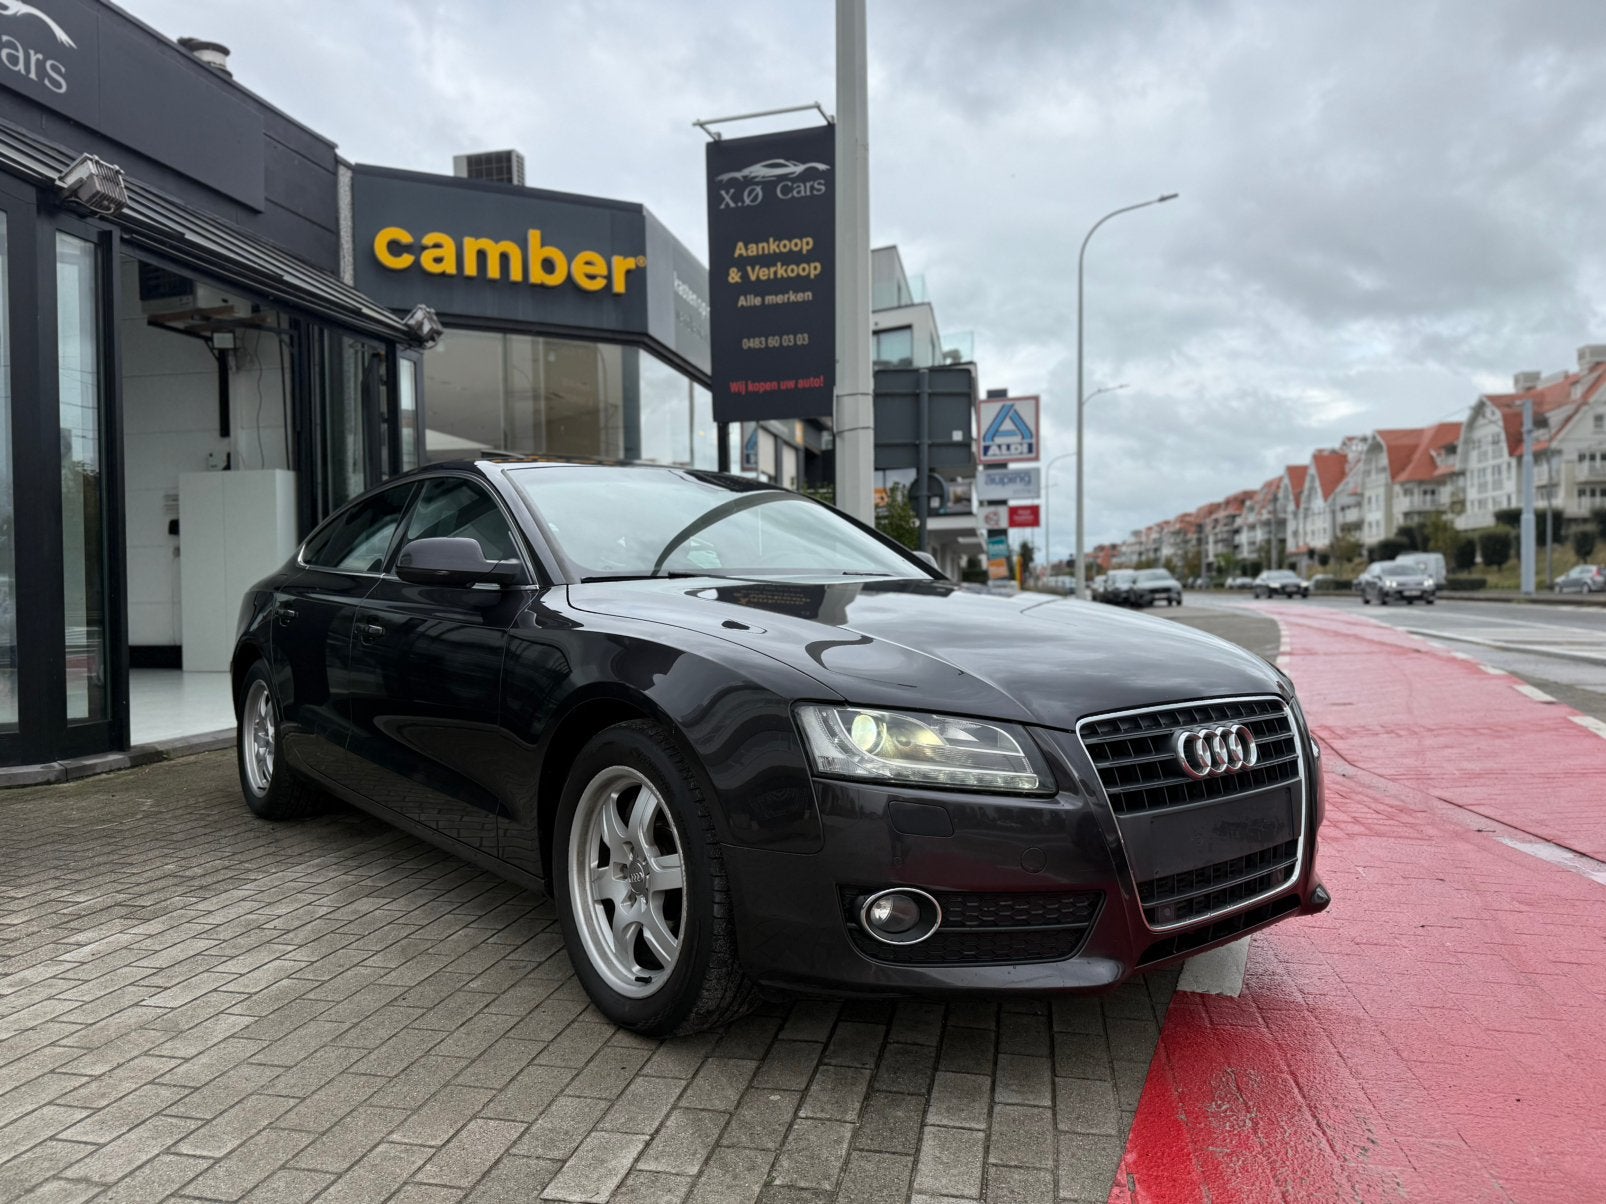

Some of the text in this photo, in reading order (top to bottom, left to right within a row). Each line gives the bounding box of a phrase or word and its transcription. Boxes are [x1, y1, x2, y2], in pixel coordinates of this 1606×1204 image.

[776, 178, 826, 200] Cars
[733, 236, 815, 258] Aankoop
[373, 226, 637, 295] camber
[727, 260, 822, 284] & Verkoop
[737, 289, 813, 308] Alle merken
[741, 333, 809, 350] 0483 60 03 03
[729, 375, 824, 395] Wij kopen uw auto!
[986, 442, 1029, 457] ALDI
